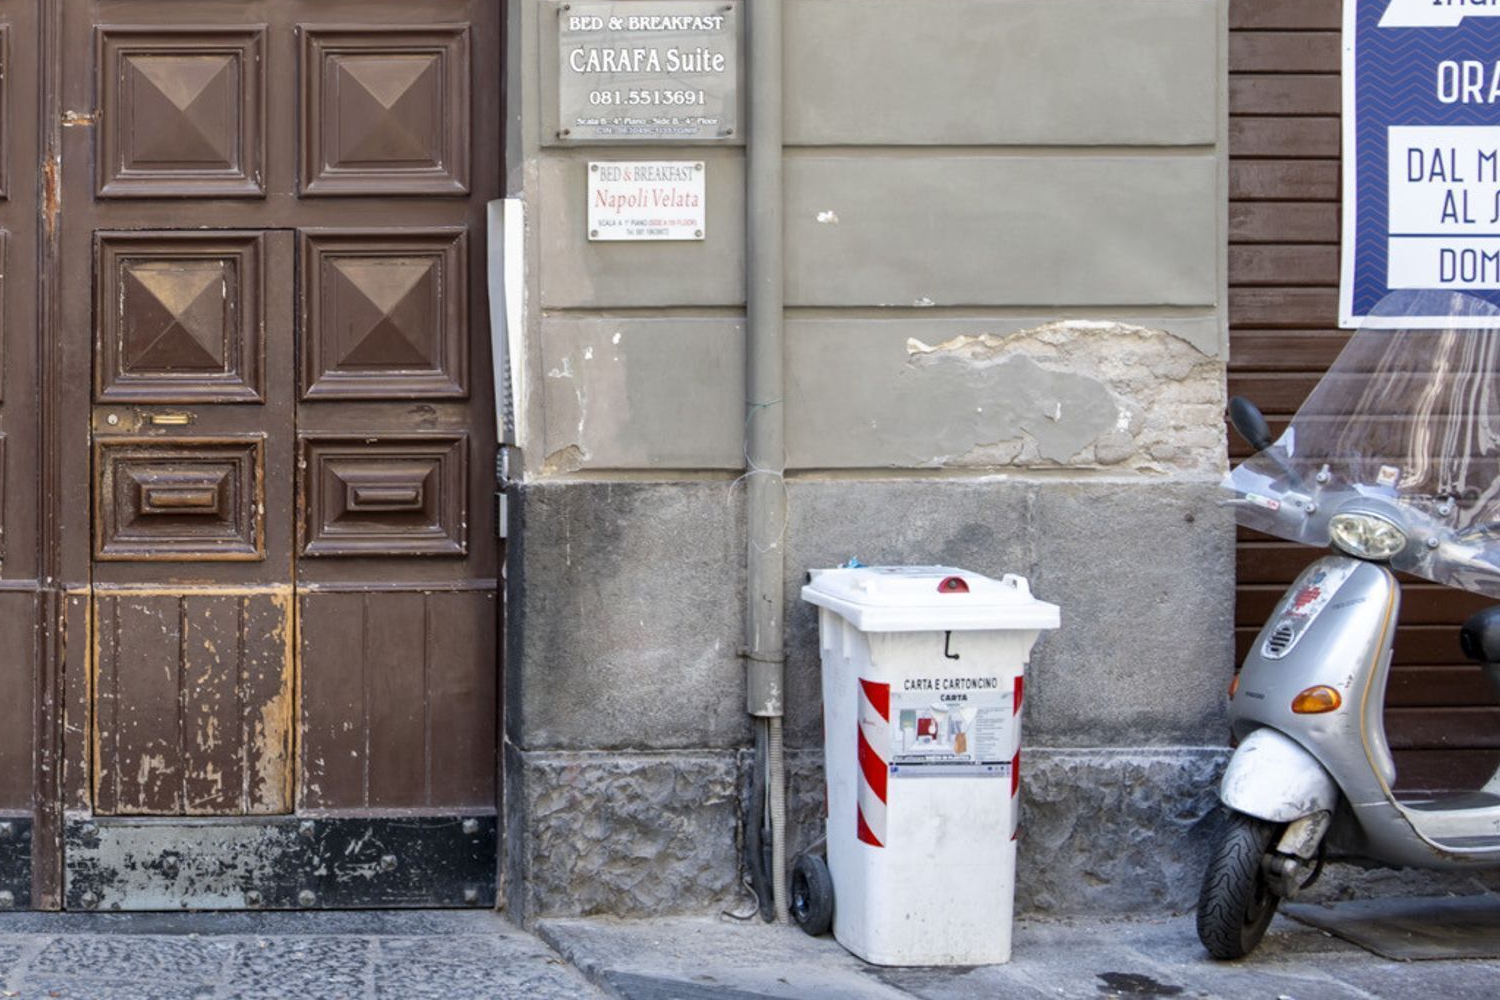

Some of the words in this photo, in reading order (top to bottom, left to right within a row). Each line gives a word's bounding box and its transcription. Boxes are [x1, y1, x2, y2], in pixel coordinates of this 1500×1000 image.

[569, 16, 603, 31] BED
[608, 16, 624, 31] &
[628, 16, 724, 31] BREAKFAST
[569, 48, 662, 73] CARAFA
[666, 48, 725, 73] Suite
[589, 90, 706, 106] 081.5513691
[600, 166, 621, 181] BED
[623, 167, 632, 181] &
[634, 166, 694, 181] BREAKFAST
[1407, 148, 1464, 183] DAL
[595, 187, 648, 214] Napoli
[652, 187, 699, 207] Velata
[1440, 189, 1475, 224] AL
[1439, 248, 1500, 283] DOM
[904, 679, 933, 690] CARTA
[935, 678, 940, 690] E
[942, 677, 998, 690] CARTONCINO
[940, 694, 968, 702] CARTA
